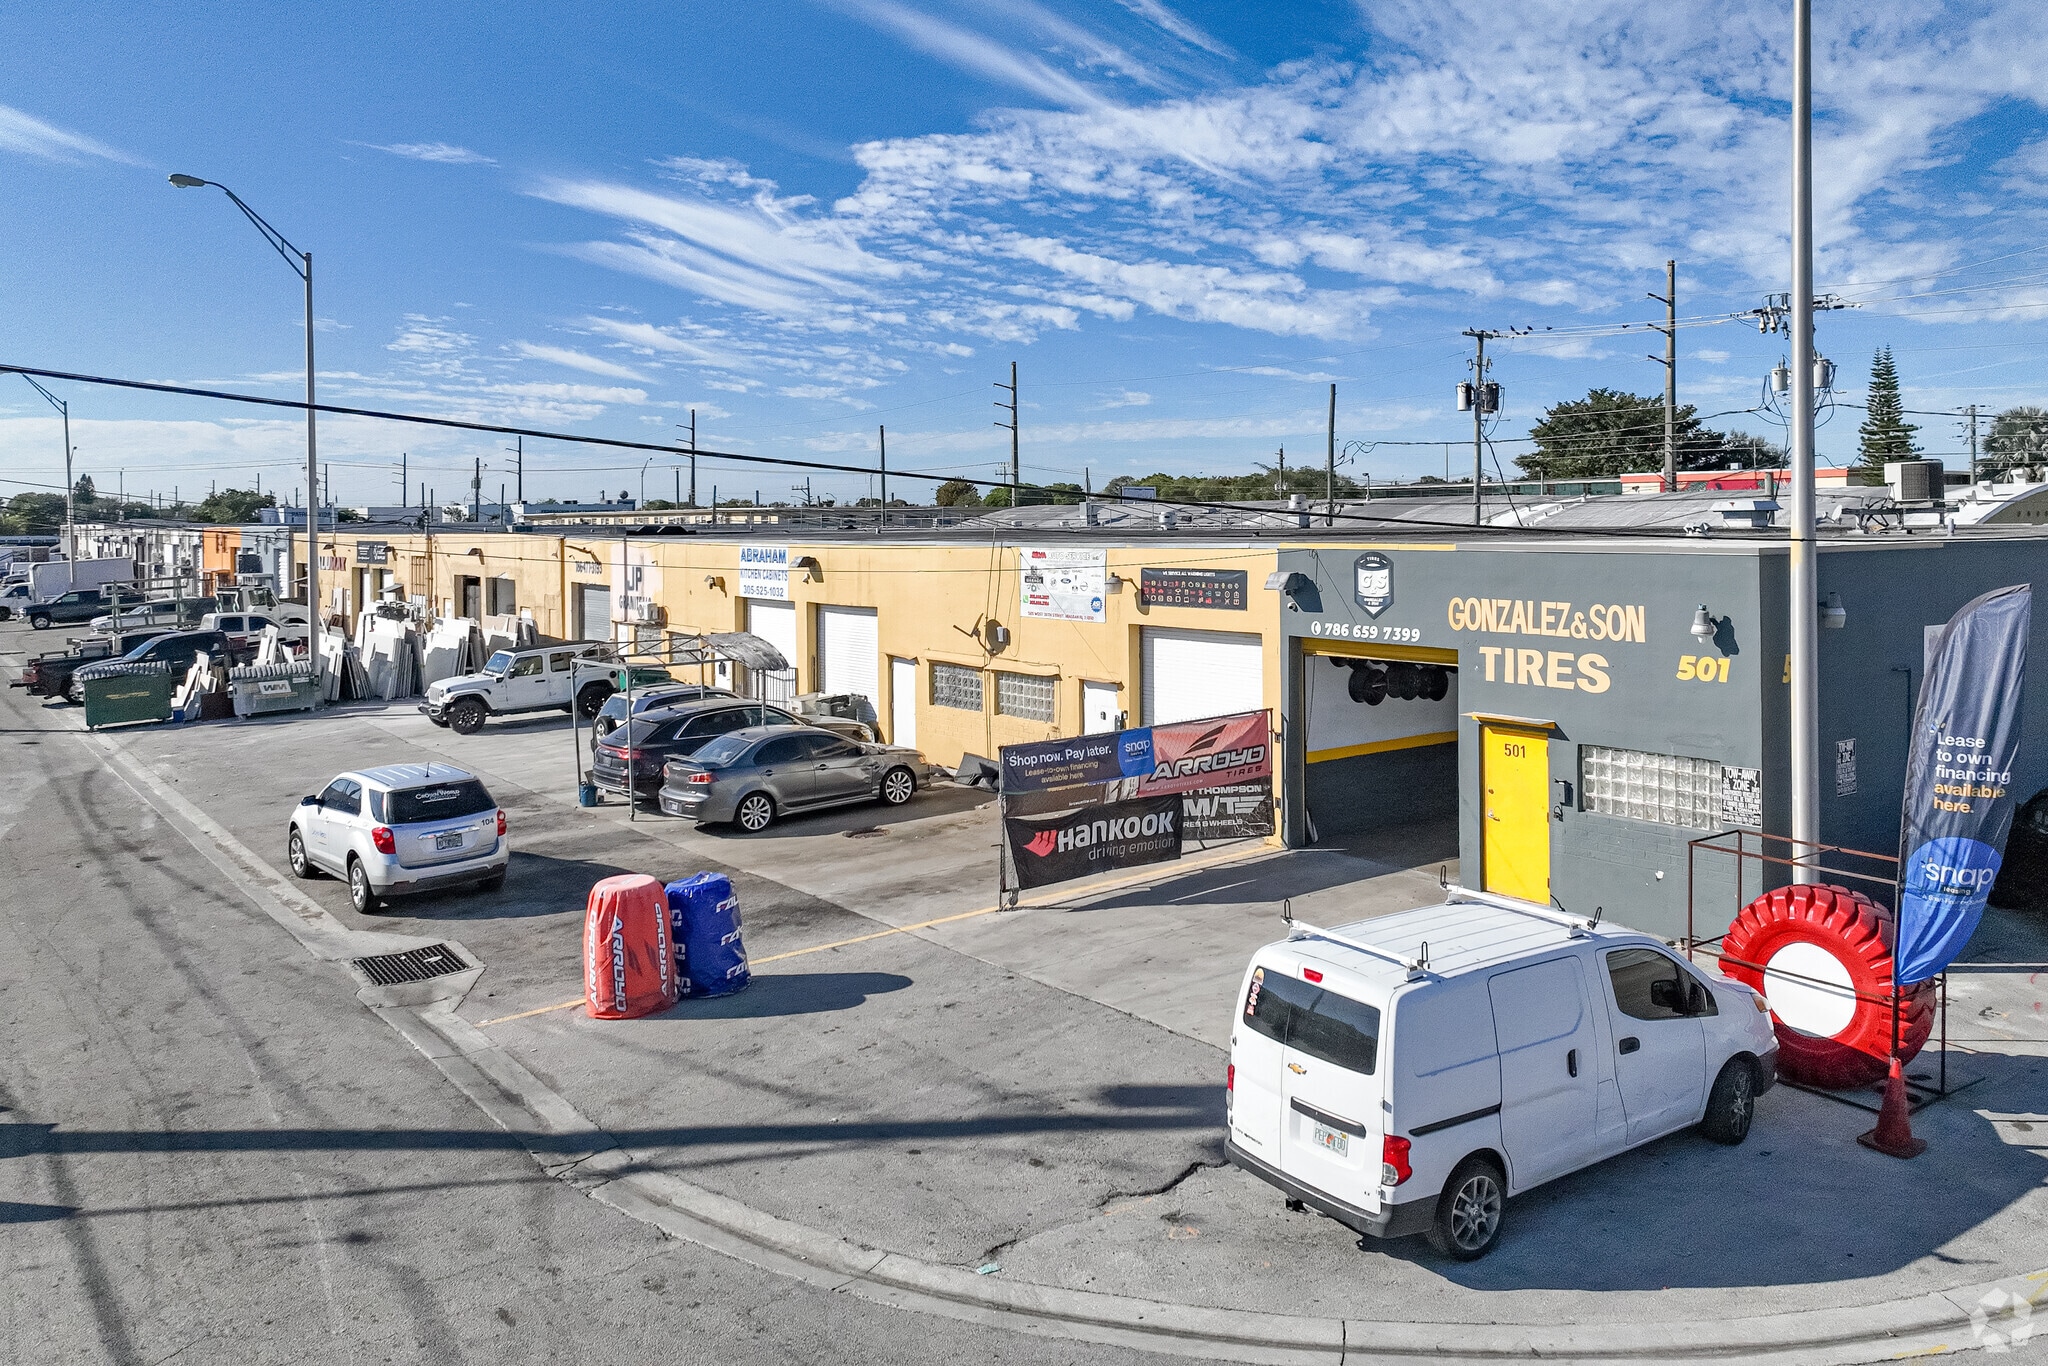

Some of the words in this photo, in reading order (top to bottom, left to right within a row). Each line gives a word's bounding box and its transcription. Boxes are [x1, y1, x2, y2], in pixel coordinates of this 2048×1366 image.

[741, 548, 787, 564] ABRAHAM
[625, 566, 642, 592] JP
[740, 569, 761, 579] KITCHEN
[762, 569, 788, 581] CABINETS
[743, 584, 784, 597] 305-525-1032
[1324, 623, 1349, 637] 786
[1352, 625, 1378, 639] 659
[1383, 627, 1421, 642] 7399
[1479, 646, 1611, 694] TIRES
[1676, 654, 1730, 683] 501
[1125, 739, 1150, 752] snap
[1937, 732, 1985, 748] Lease
[1009, 755, 1038, 768] Shop
[1040, 753, 1064, 764] now.
[1065, 748, 1084, 762] Pay
[1087, 745, 1112, 757] later.
[1504, 743, 1526, 758] 501
[1936, 750, 1952, 762] to
[1957, 752, 1992, 765] own
[1025, 766, 1069, 777] Lease-to-own
[1070, 760, 1099, 771] financing
[1146, 744, 1265, 783] ARROYO
[1226, 765, 1262, 778] TIRES
[1041, 774, 1068, 784] available
[1069, 772, 1084, 780] here.
[1724, 767, 1757, 780] TOW-AWAY
[1935, 765, 2011, 784] financing
[1196, 785, 1262, 795] THOMPSON
[1733, 779, 1751, 791] ZONE
[1934, 783, 2006, 799] available
[1933, 797, 1974, 814] here.
[481, 818, 494, 826] 104
[1209, 819, 1243, 827] WHEELS
[1088, 844, 1126, 860] driving
[1129, 837, 1175, 853] emotion
[1925, 862, 1994, 893] snap
[1943, 886, 1971, 896] leasing
[655, 903, 668, 997] ARROYO
[588, 910, 599, 1009] ARROYO
[612, 914, 628, 1012] ARROYO
